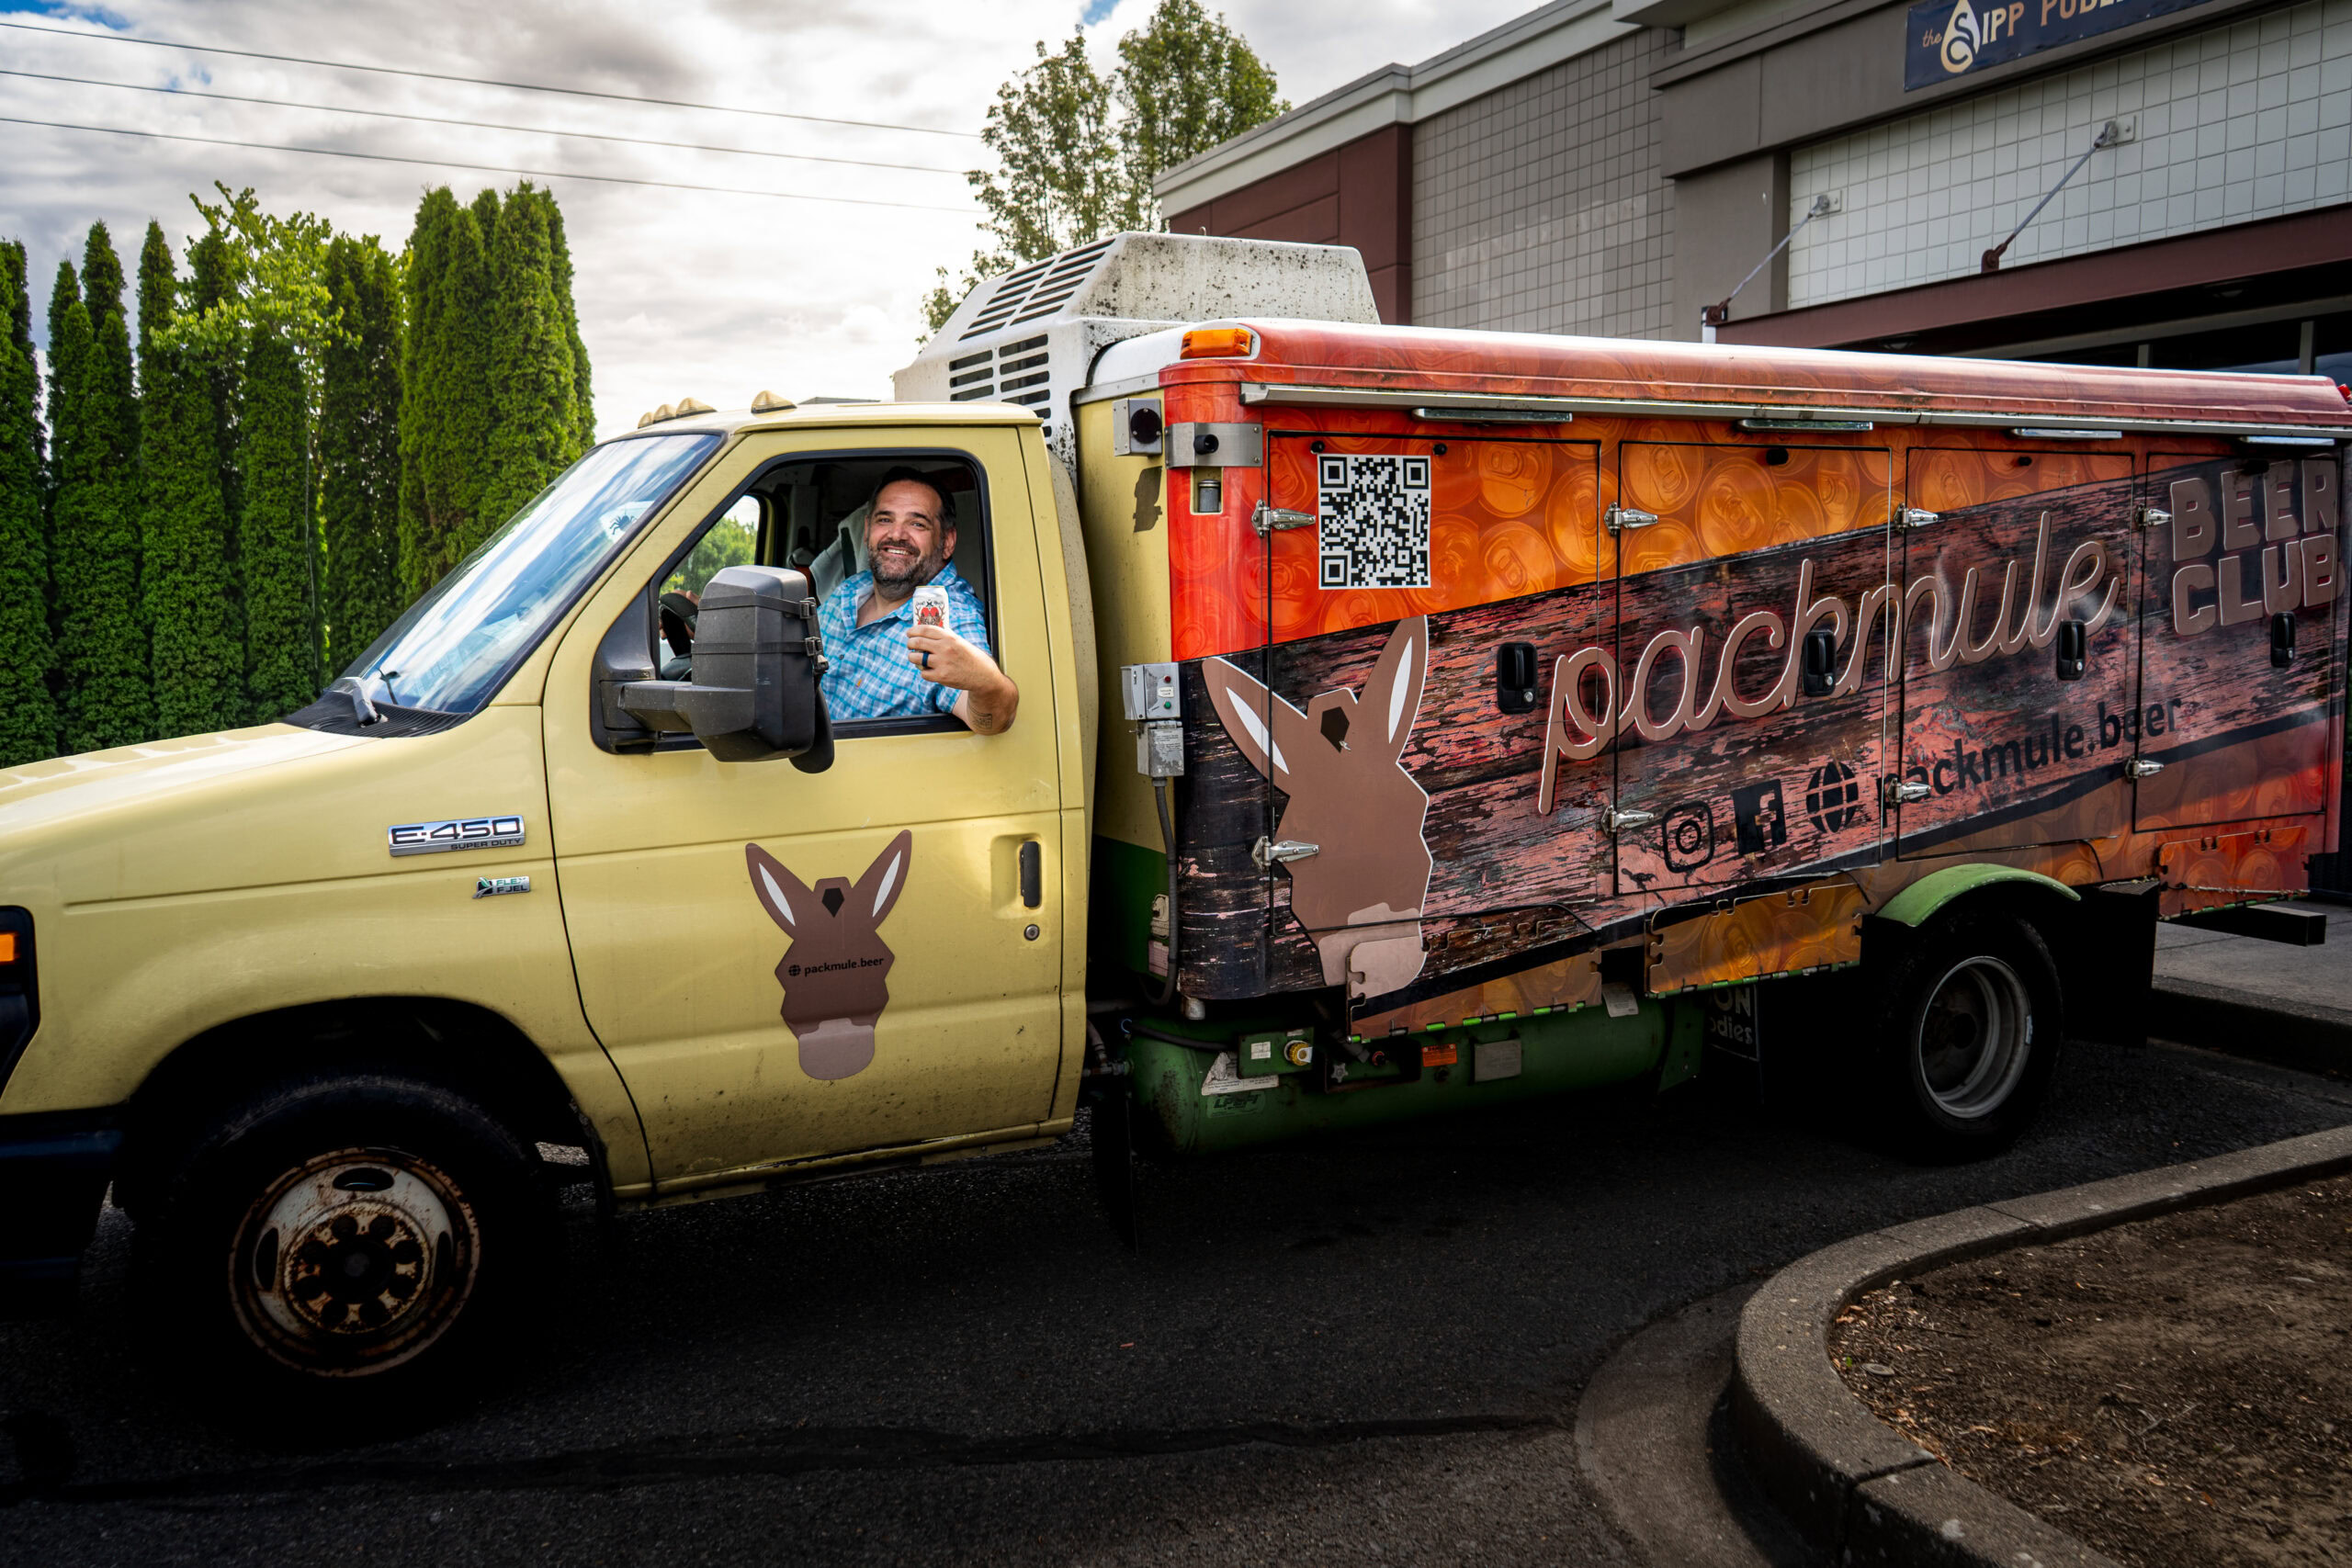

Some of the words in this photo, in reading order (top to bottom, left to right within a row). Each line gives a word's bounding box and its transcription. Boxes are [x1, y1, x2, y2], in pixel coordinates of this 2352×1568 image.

[1922, 28, 1942, 47] the
[2170, 453, 2338, 562] BEER
[2172, 534, 2346, 636] CLUB
[1538, 510, 2120, 815] packmule
[450, 840, 489, 851] SUPER
[491, 838, 521, 847] DUTY
[804, 957, 885, 976] packmule.beer
